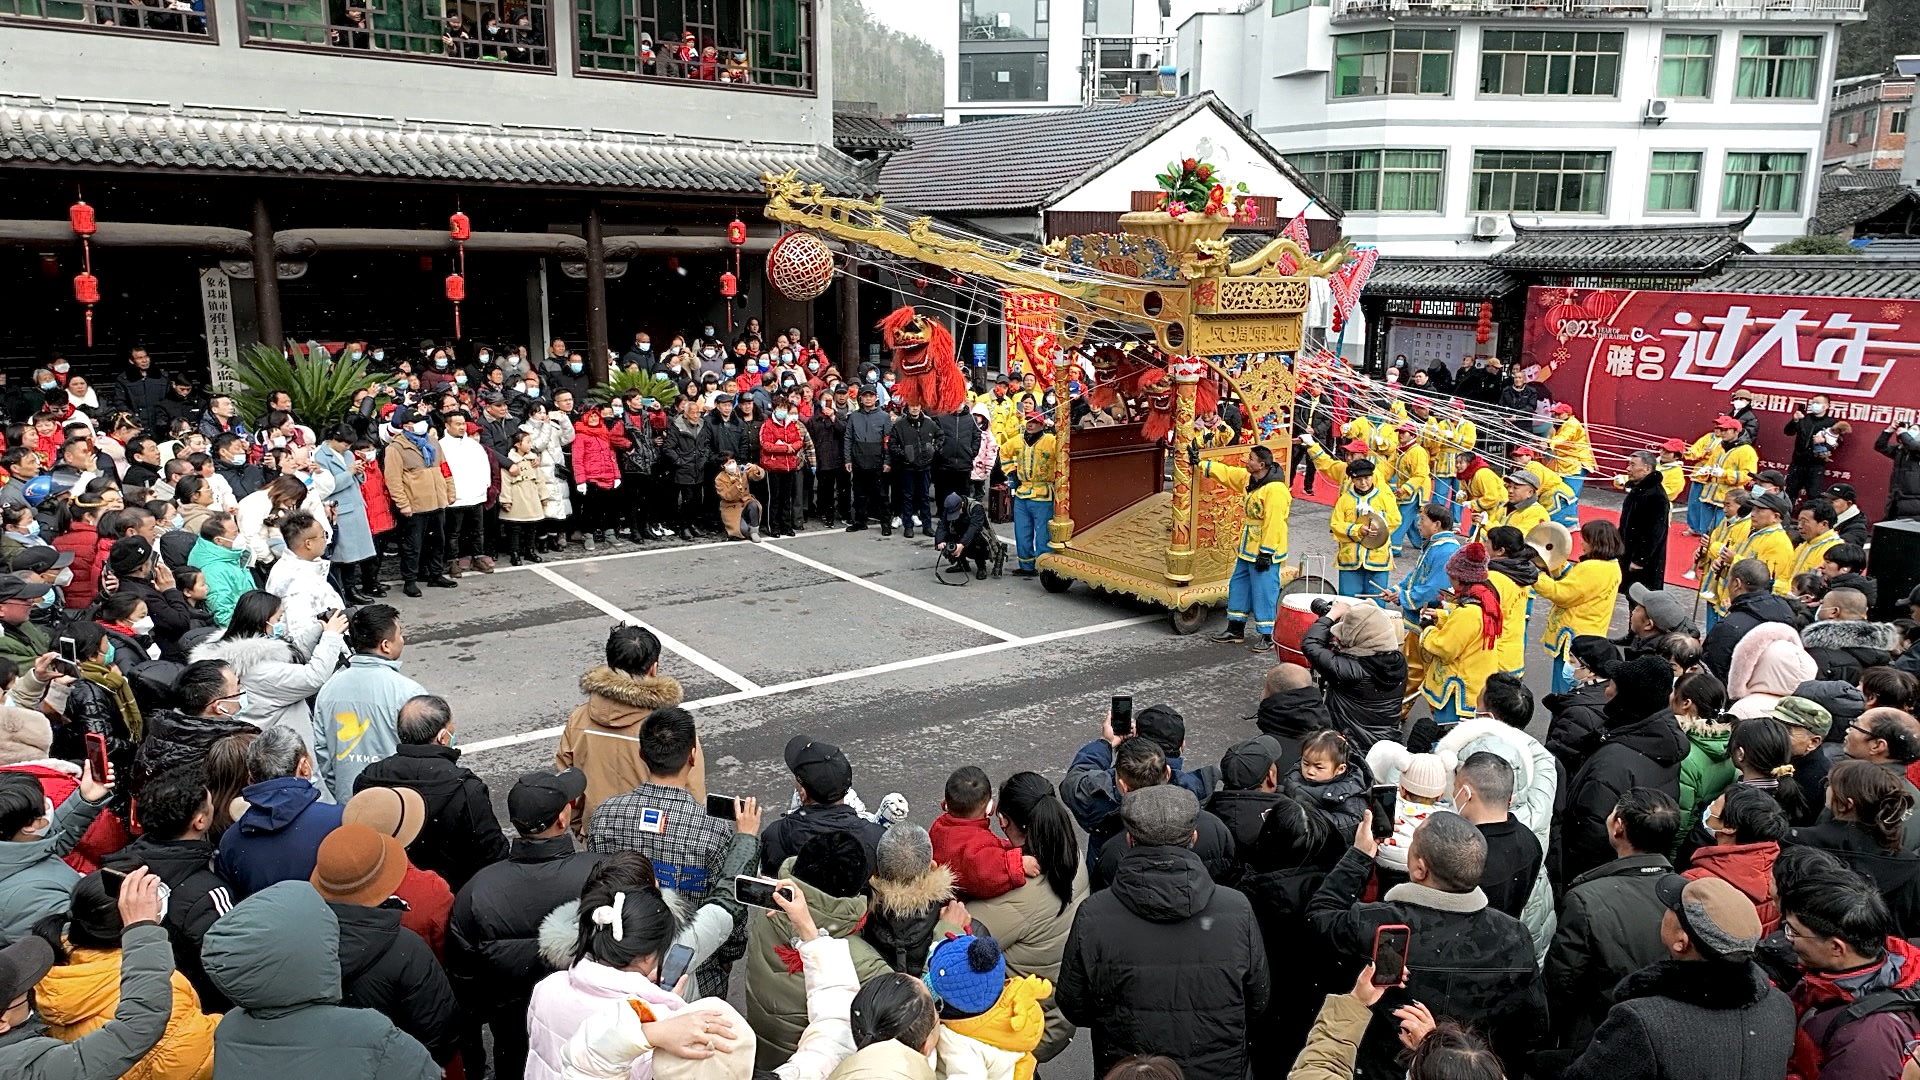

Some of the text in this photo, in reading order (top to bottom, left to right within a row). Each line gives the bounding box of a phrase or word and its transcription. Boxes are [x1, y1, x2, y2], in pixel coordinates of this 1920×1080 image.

[1206, 324, 1289, 344] 风调雨顺
[1557, 318, 1597, 340] 2023
[1660, 306, 1920, 398] 过大年
